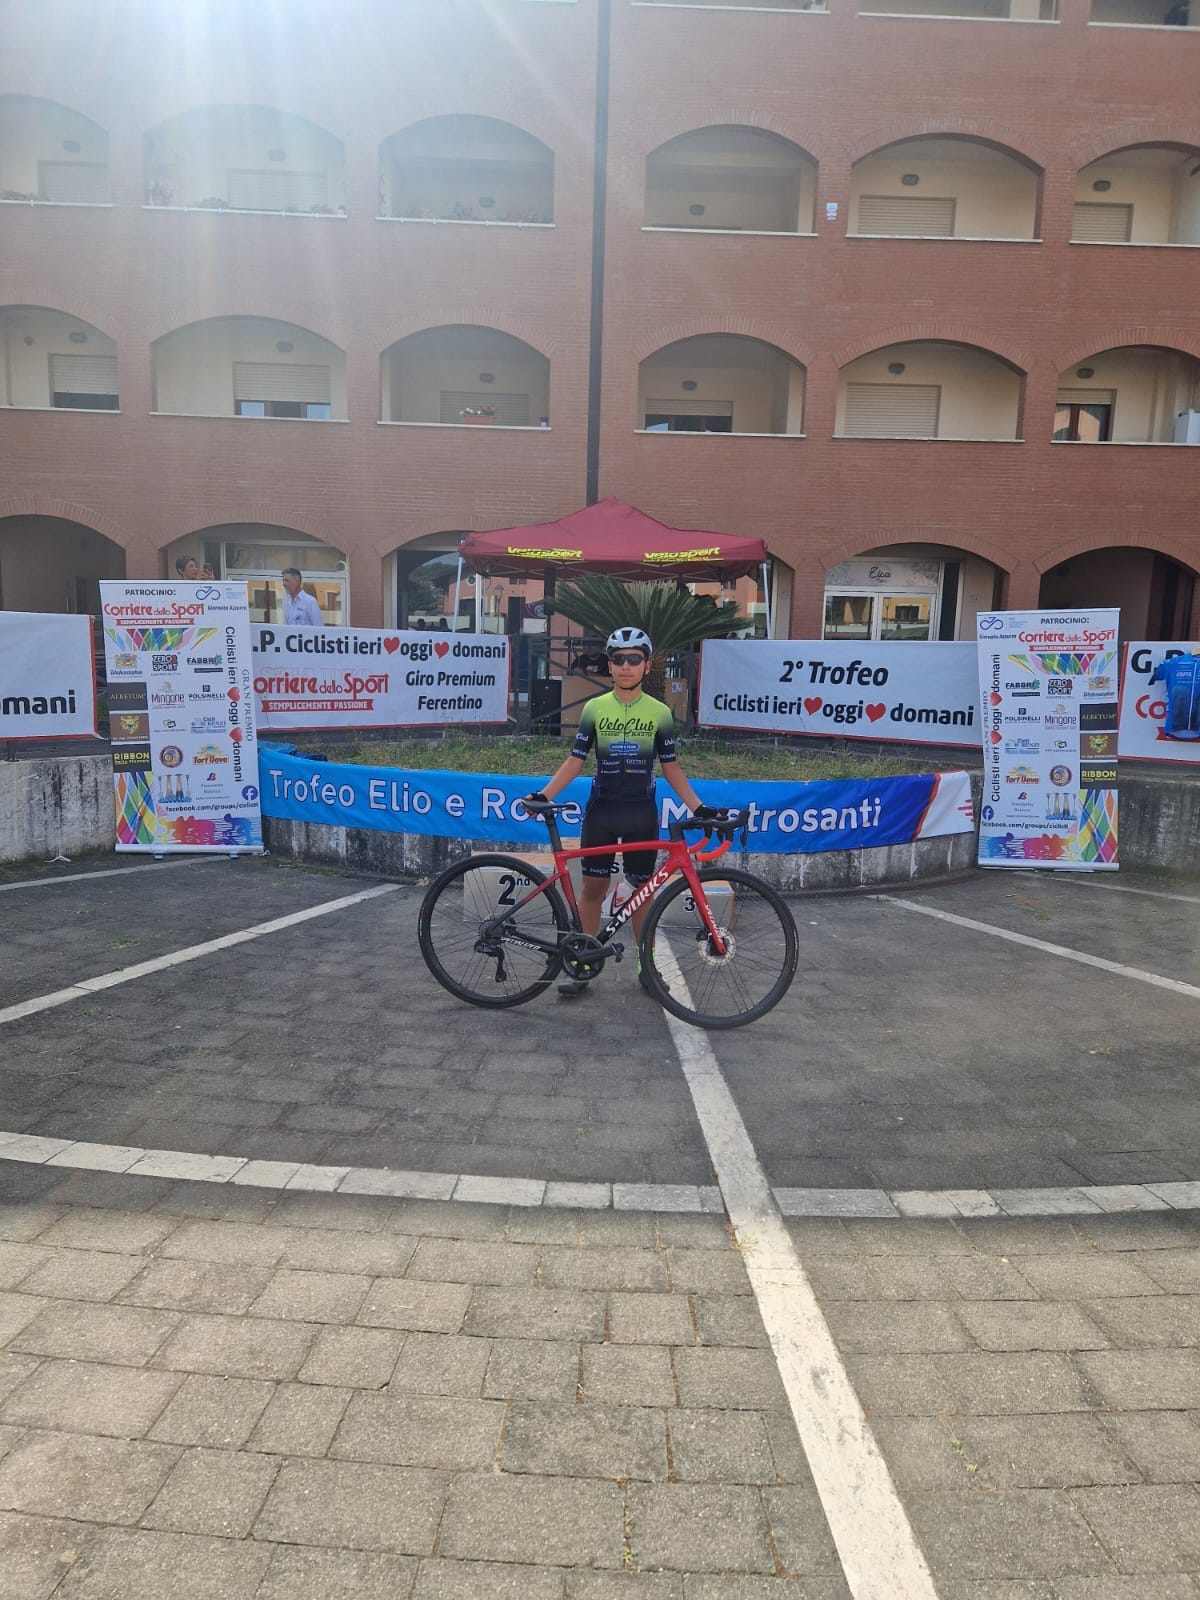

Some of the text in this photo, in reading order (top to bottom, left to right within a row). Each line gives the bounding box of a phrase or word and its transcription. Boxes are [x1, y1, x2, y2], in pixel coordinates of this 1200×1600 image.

[104, 603, 153, 616] Corriere
[171, 603, 205, 618] Sport
[1040, 617, 1090, 625] PATROCINIO:
[285, 634, 349, 655] Ciclisti
[353, 636, 382, 656] ieri
[400, 639, 433, 661] oggi
[453, 641, 506, 659] domani
[1018, 631, 1065, 643] Corriere
[1083, 629, 1116, 645] Sport
[253, 672, 389, 700] orriere dello Sport
[405, 670, 496, 687] Giro Premium
[779, 660, 889, 687] 2° Trofeo
[0, 689, 76, 715] mani
[226, 626, 245, 783] Ciclisti ieri oggi domani
[242, 669, 253, 742] GRAN PREMIO
[268, 701, 368, 711] SEMPLICEMENTE PASSIONE
[417, 694, 483, 711] Ferentino
[713, 693, 974, 726] Ciclisti ieri oggi domani
[991, 654, 1002, 802] Ciclisti ieri oggi domani
[114, 752, 149, 760] RIBBON
[1081, 770, 1117, 778] RIBBON
[269, 769, 355, 807] Trofeo
[367, 779, 432, 815] Elio
[445, 794, 465, 818] e
